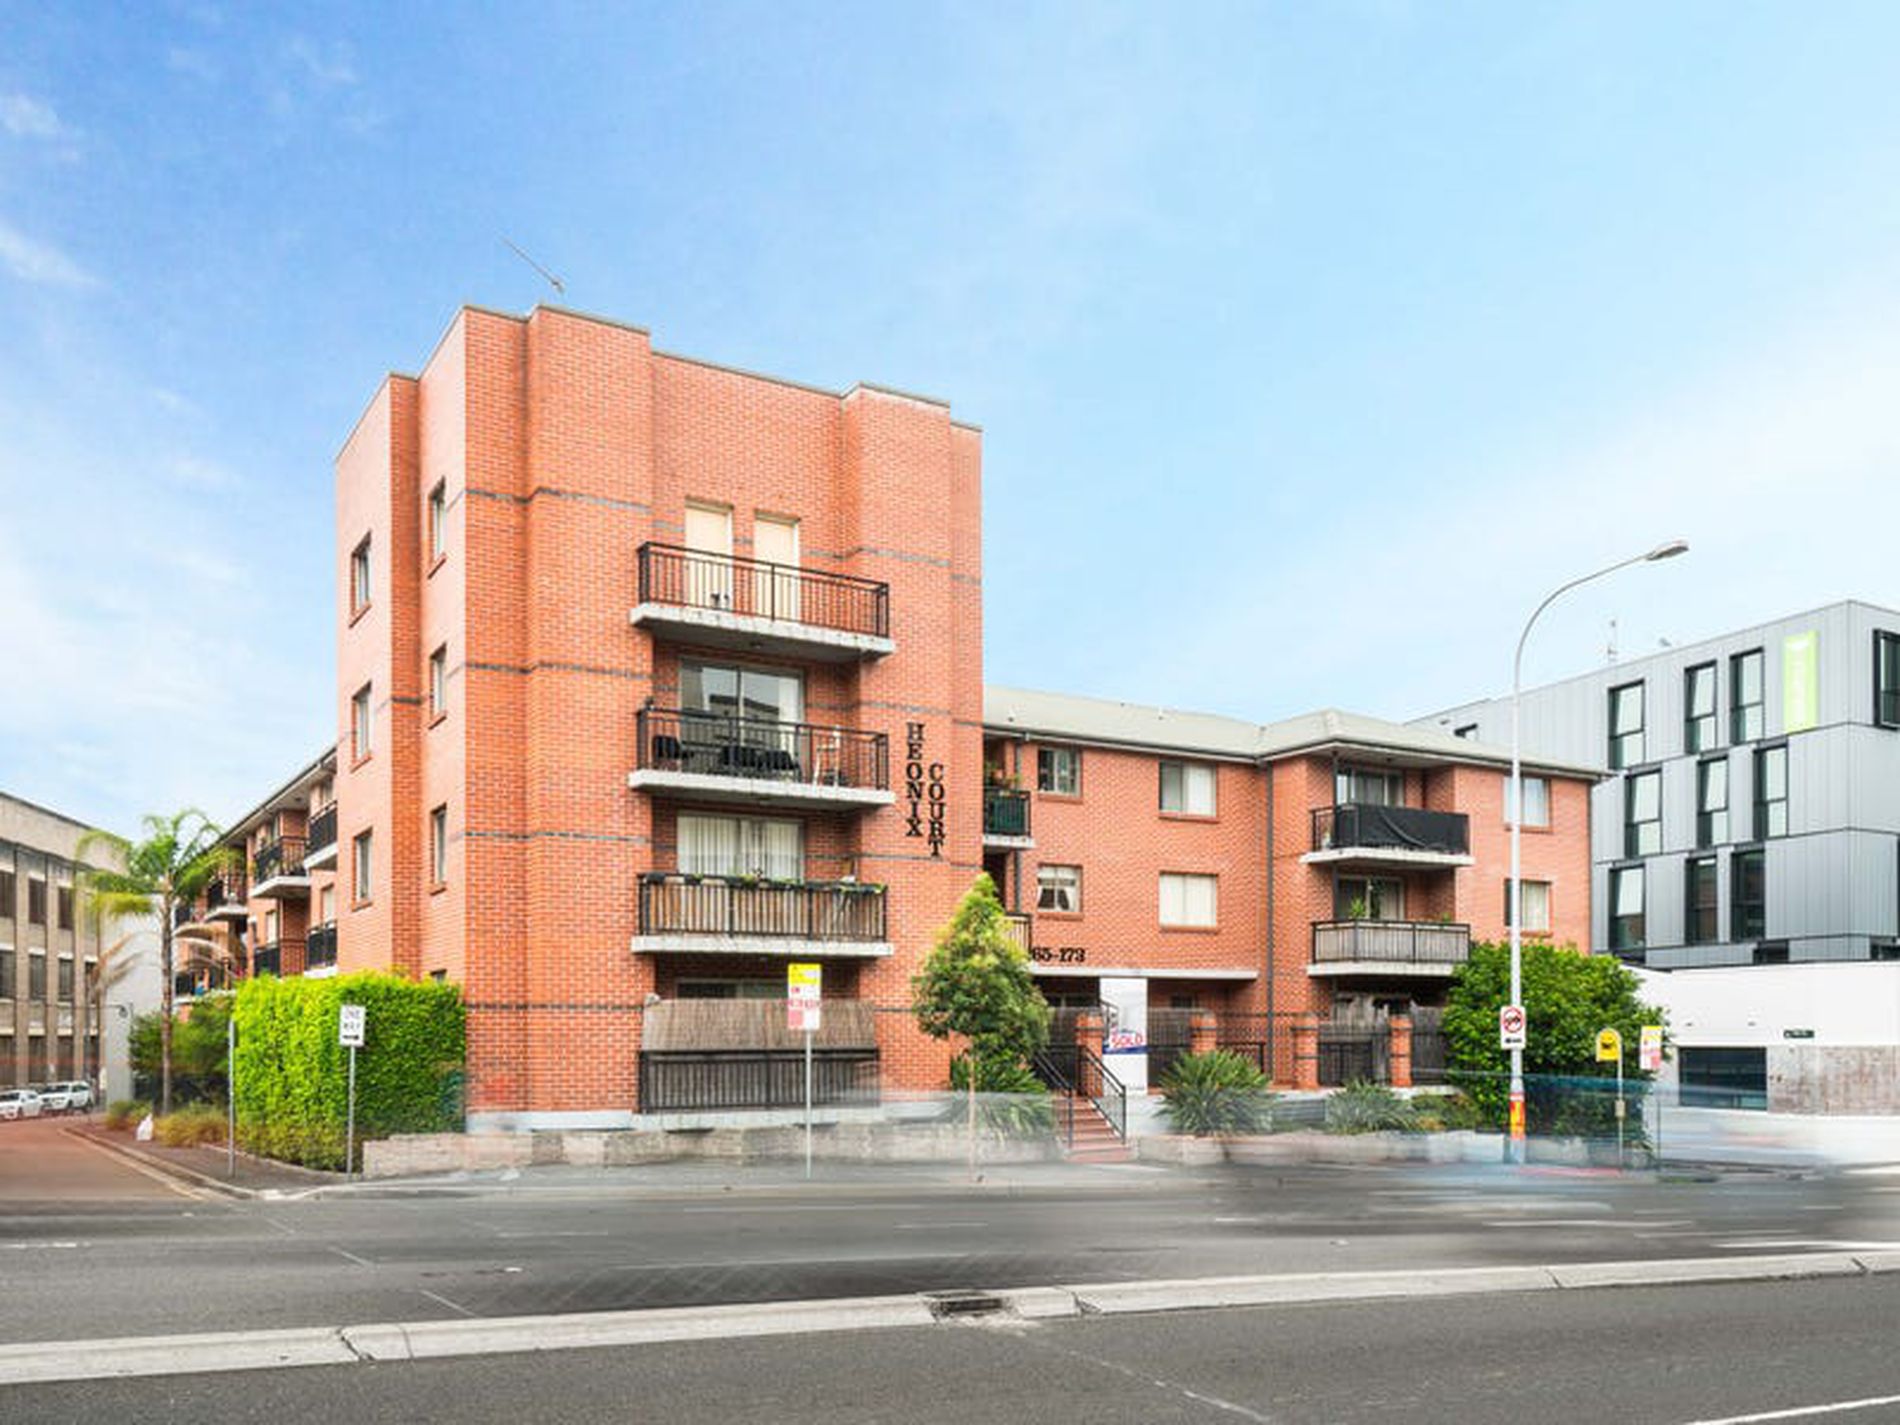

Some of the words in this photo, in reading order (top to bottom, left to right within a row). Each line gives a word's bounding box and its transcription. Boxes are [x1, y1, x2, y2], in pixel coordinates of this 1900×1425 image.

[906, 722, 925, 837] HEONIX
[928, 762, 946, 858] COURT
[1111, 1031, 1143, 1048] SOLD
